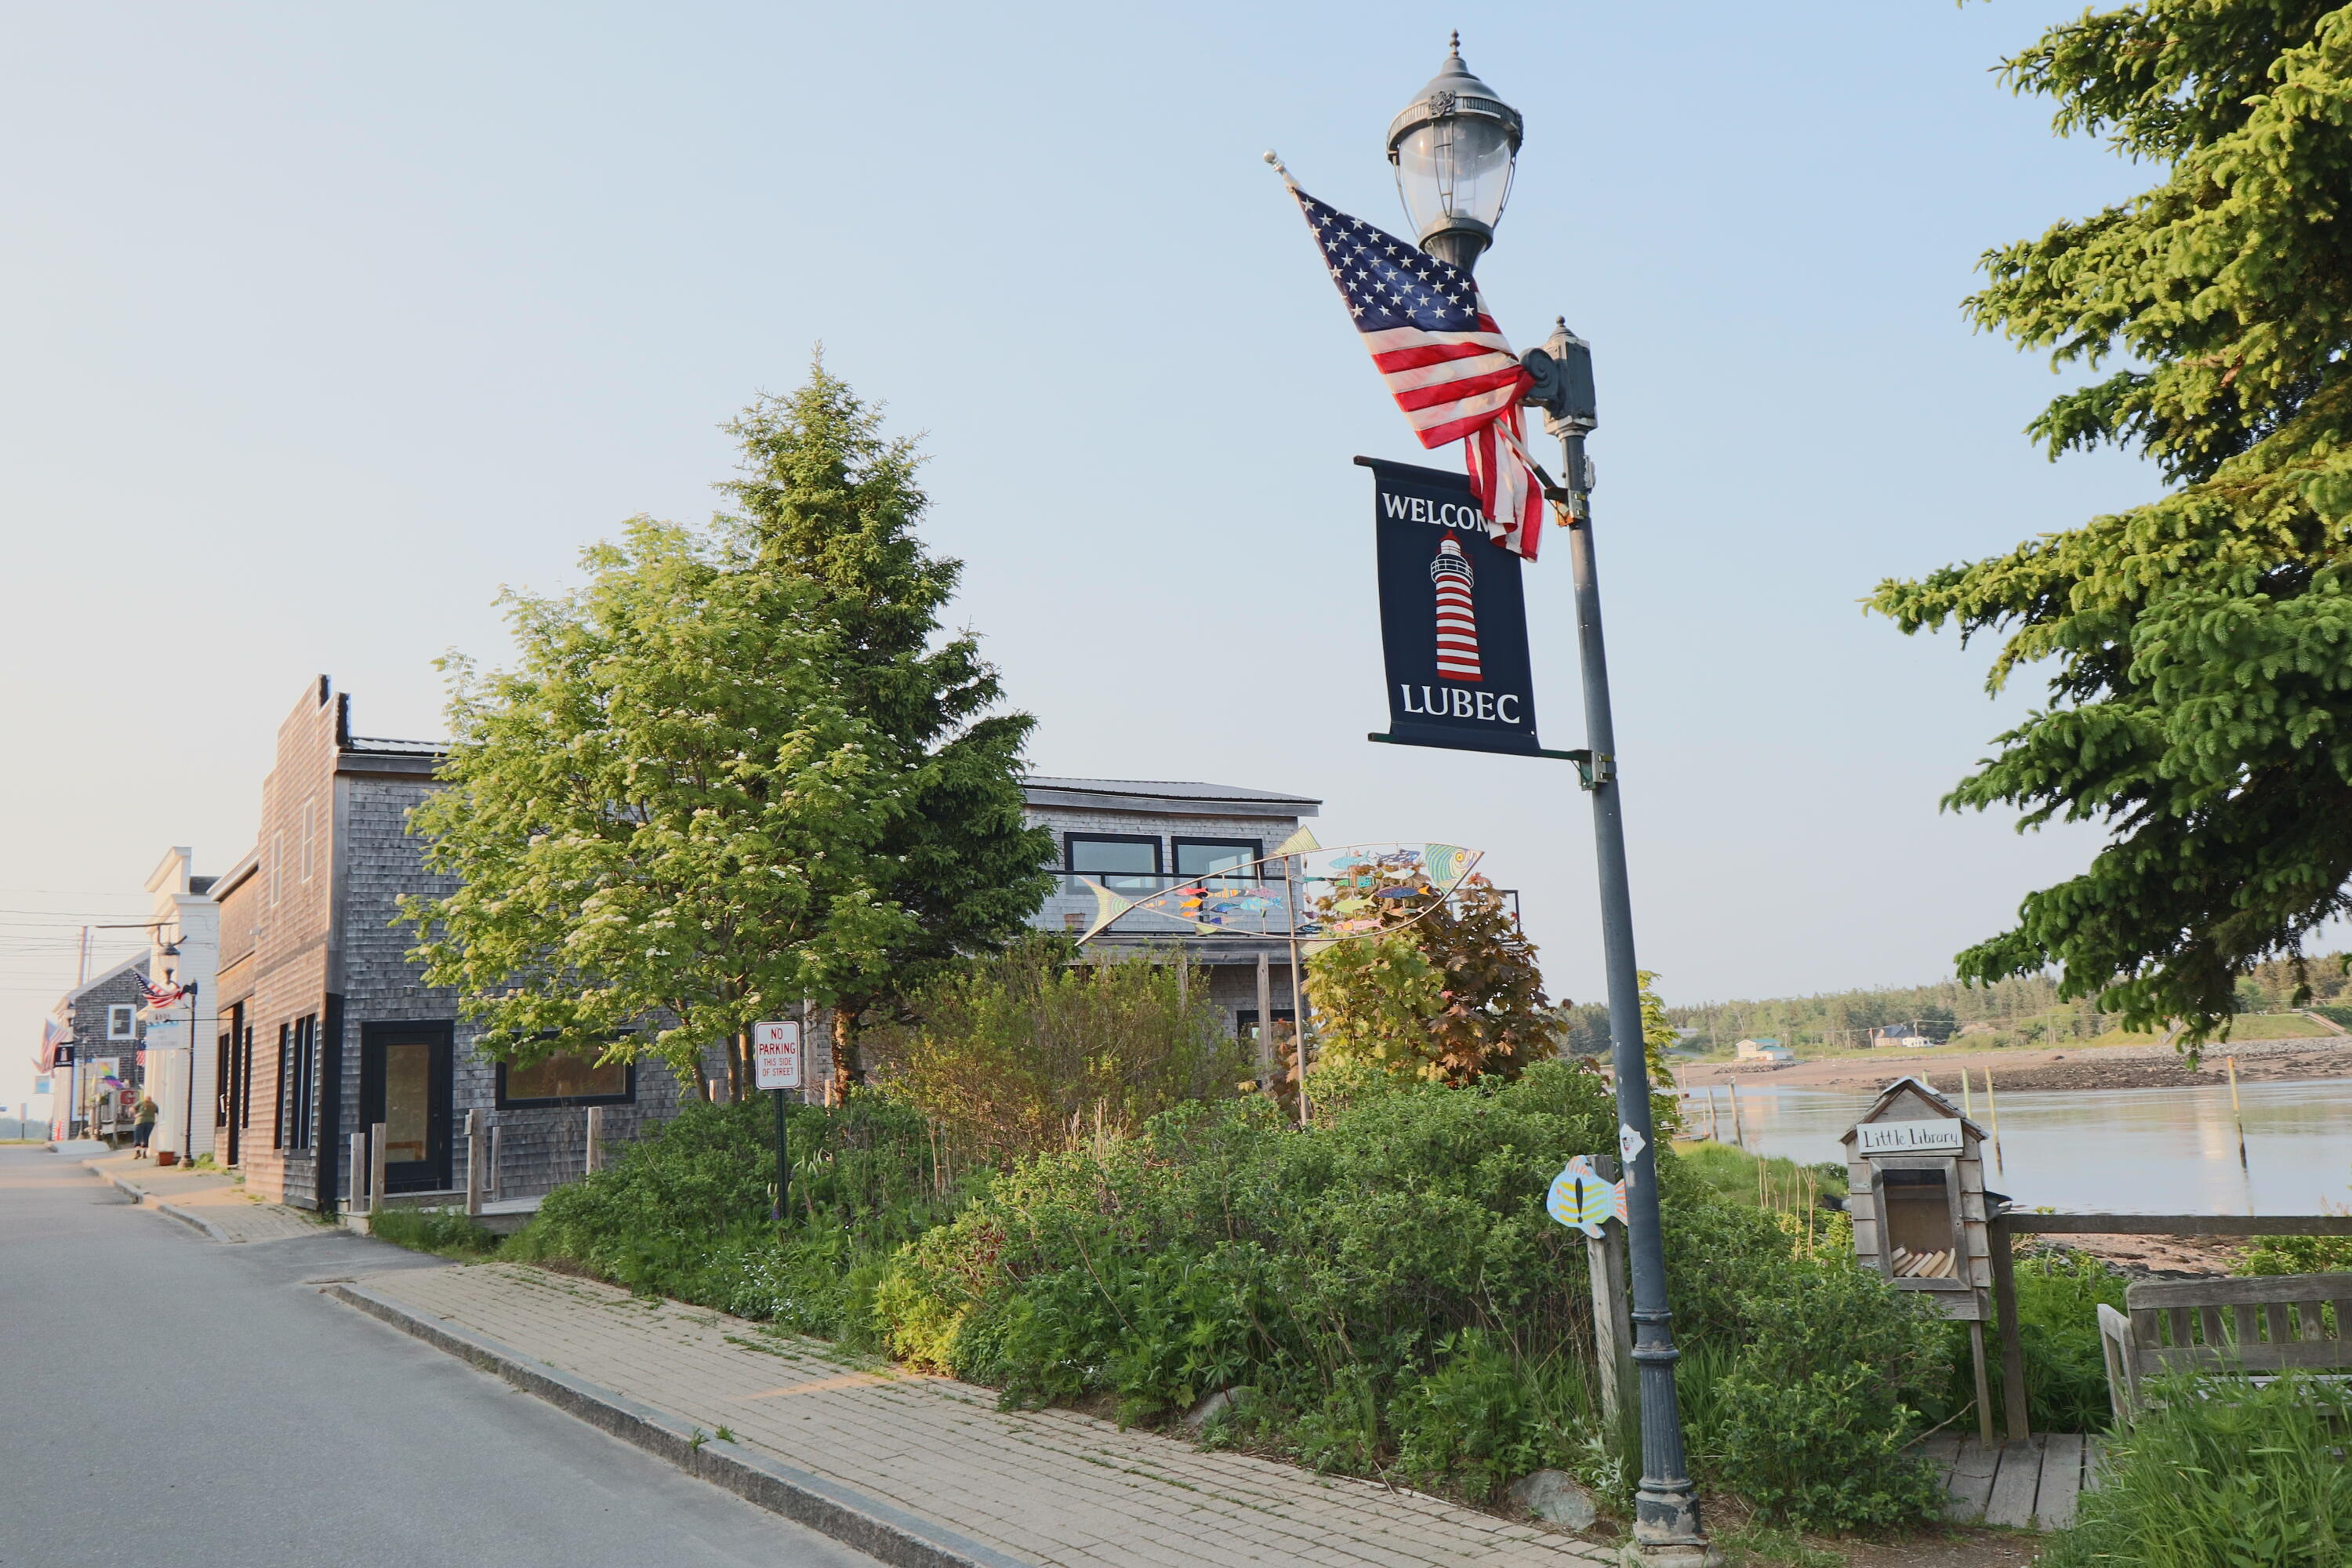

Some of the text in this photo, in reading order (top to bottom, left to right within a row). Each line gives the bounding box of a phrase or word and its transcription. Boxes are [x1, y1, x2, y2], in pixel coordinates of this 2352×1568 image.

[1400, 684, 1520, 724] LUBEC
[771, 1029, 782, 1040] NO
[759, 1043, 796, 1055] PARKING
[779, 1058, 793, 1066] SIDE
[762, 1067, 794, 1077] OF STREET
[1863, 1127, 1958, 1148] Little Library
